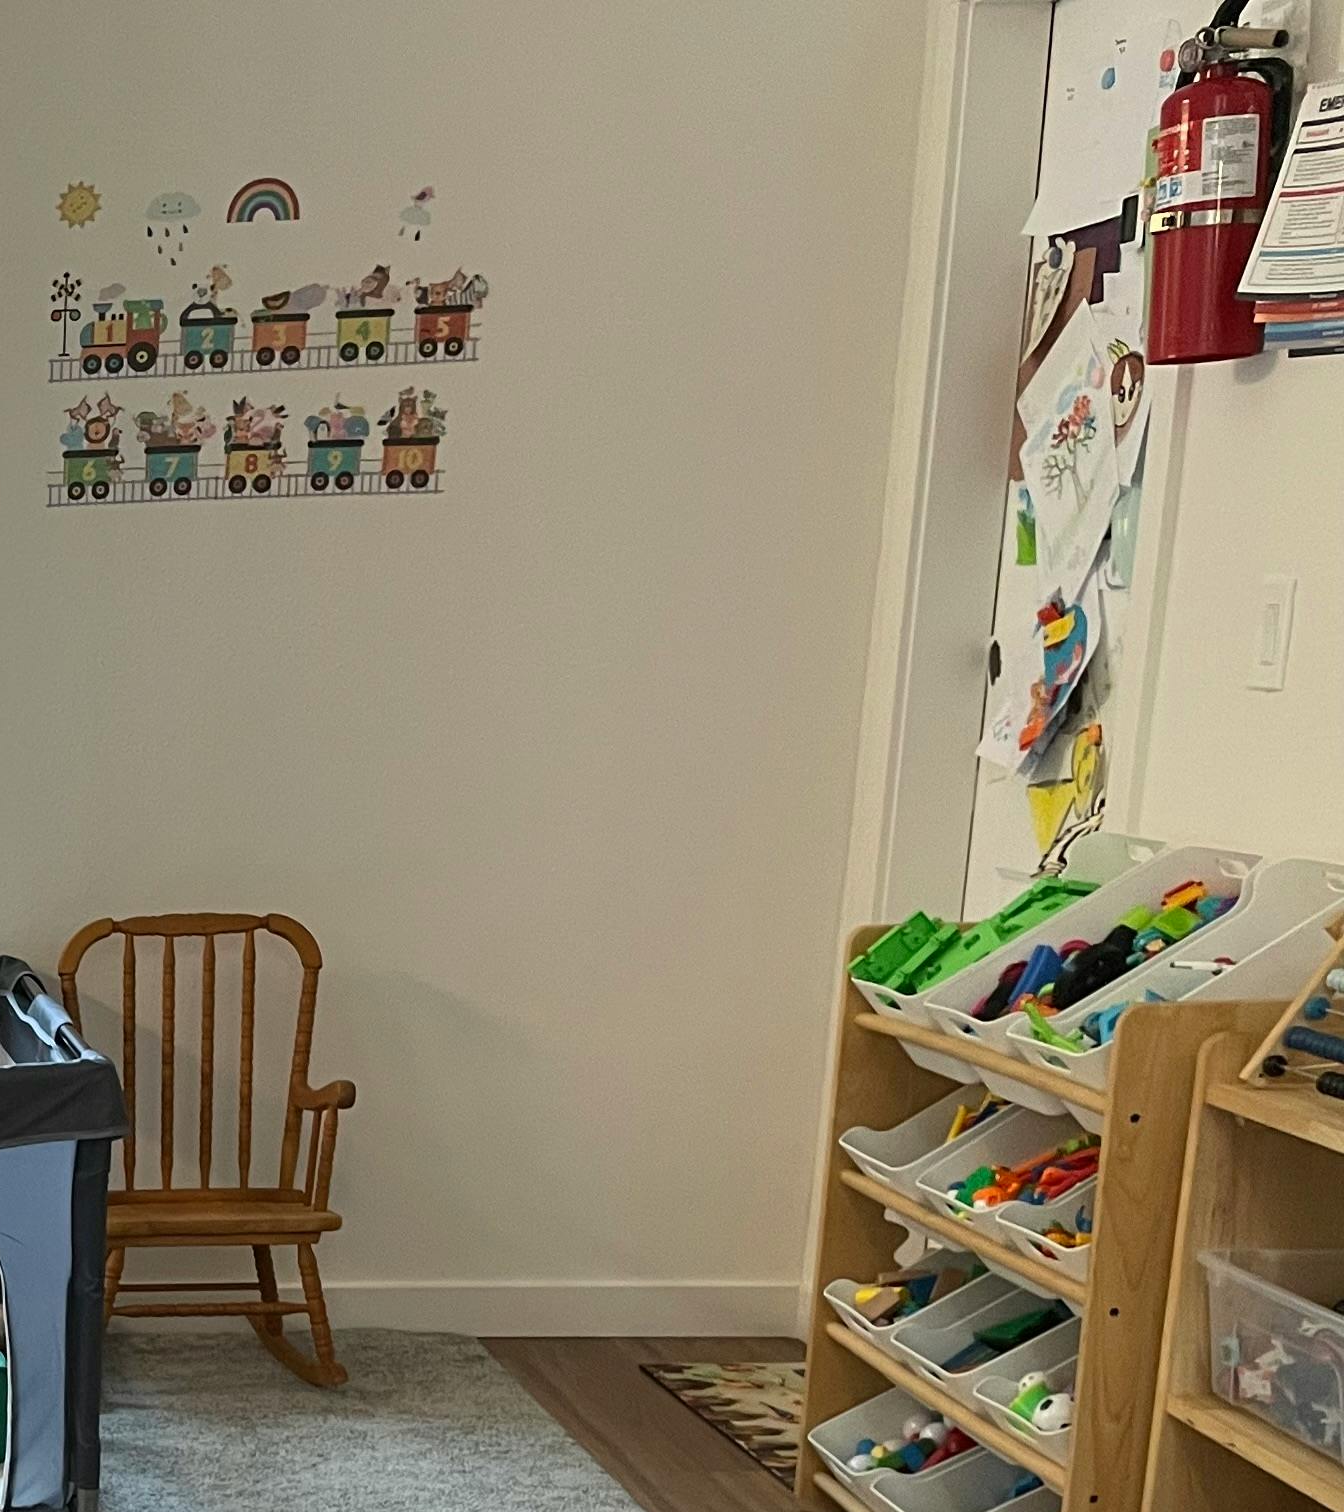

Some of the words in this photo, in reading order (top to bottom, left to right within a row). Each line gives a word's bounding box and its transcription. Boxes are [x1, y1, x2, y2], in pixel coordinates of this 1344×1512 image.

[200, 328, 216, 350] 2
[272, 325, 287, 346] 3
[355, 321, 370, 342] 4
[436, 317, 450, 337] 5
[83, 462, 96, 482] 6
[164, 456, 180, 477] 7
[244, 453, 258, 474] 8
[327, 449, 342, 471] 9
[398, 448, 426, 468] 10
